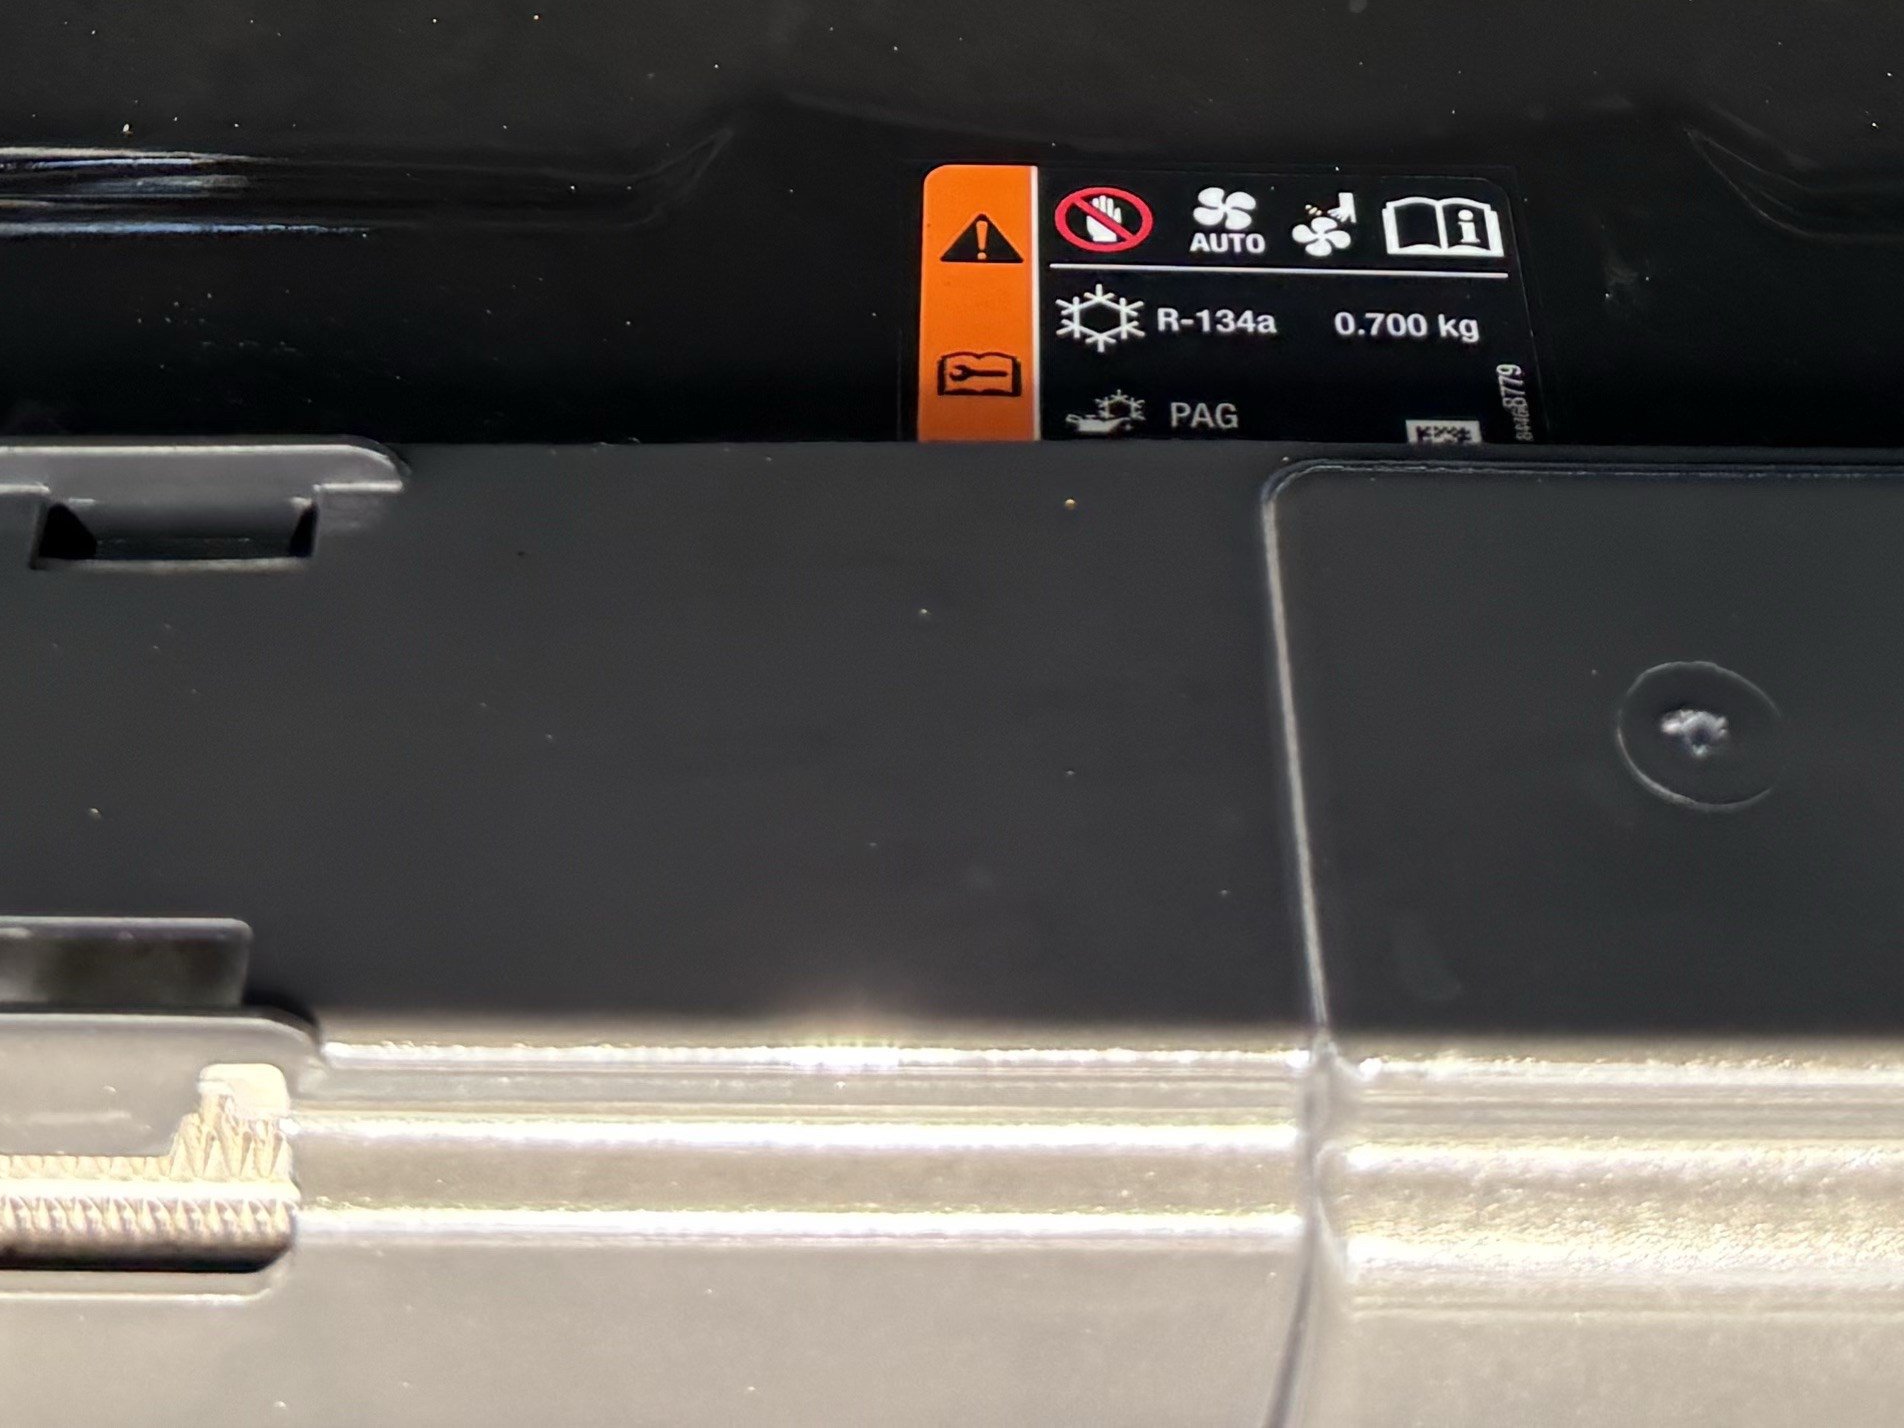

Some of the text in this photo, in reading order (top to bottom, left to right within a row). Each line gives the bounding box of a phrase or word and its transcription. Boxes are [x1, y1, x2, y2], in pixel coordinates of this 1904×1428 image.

[1189, 231, 1265, 255] AUTO
[1156, 307, 1480, 344] R-134a 0.700 kg
[1169, 402, 1240, 430] PAG
